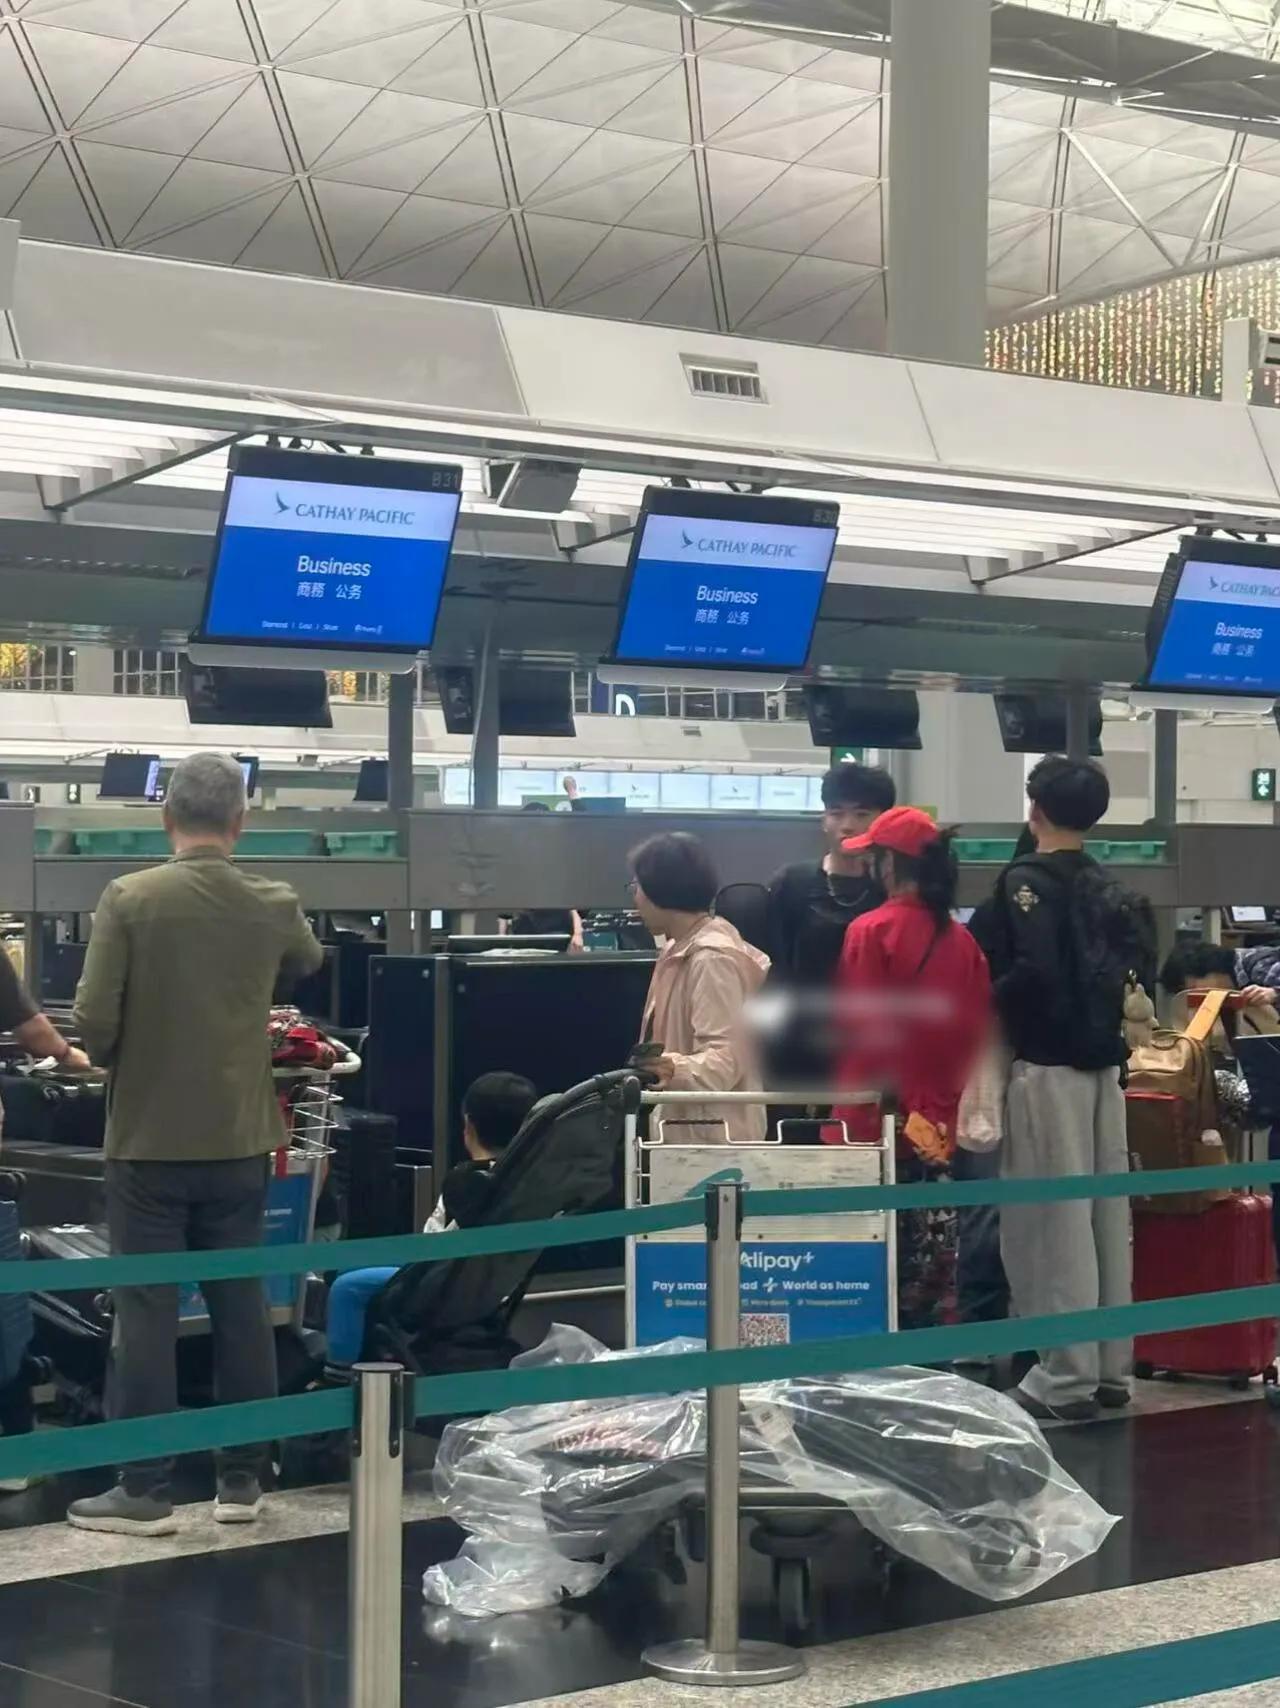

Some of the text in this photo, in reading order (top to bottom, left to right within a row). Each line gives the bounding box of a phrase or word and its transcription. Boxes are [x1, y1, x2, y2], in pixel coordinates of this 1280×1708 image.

[431, 471, 460, 489] B31
[295, 503, 415, 525] CATHAY PACIFIC
[697, 538, 797, 558] CATHAY PACIFIC
[297, 555, 372, 576] Business
[296, 582, 362, 600] 商務 公务
[696, 585, 758, 604] Business
[1220, 582, 1280, 597] CATHAY PAC
[1215, 622, 1263, 639] Business
[652, 1281, 675, 1294] Pay
[677, 1282, 707, 1291] smar
[782, 1281, 816, 1290] World
[835, 1281, 870, 1290] home
